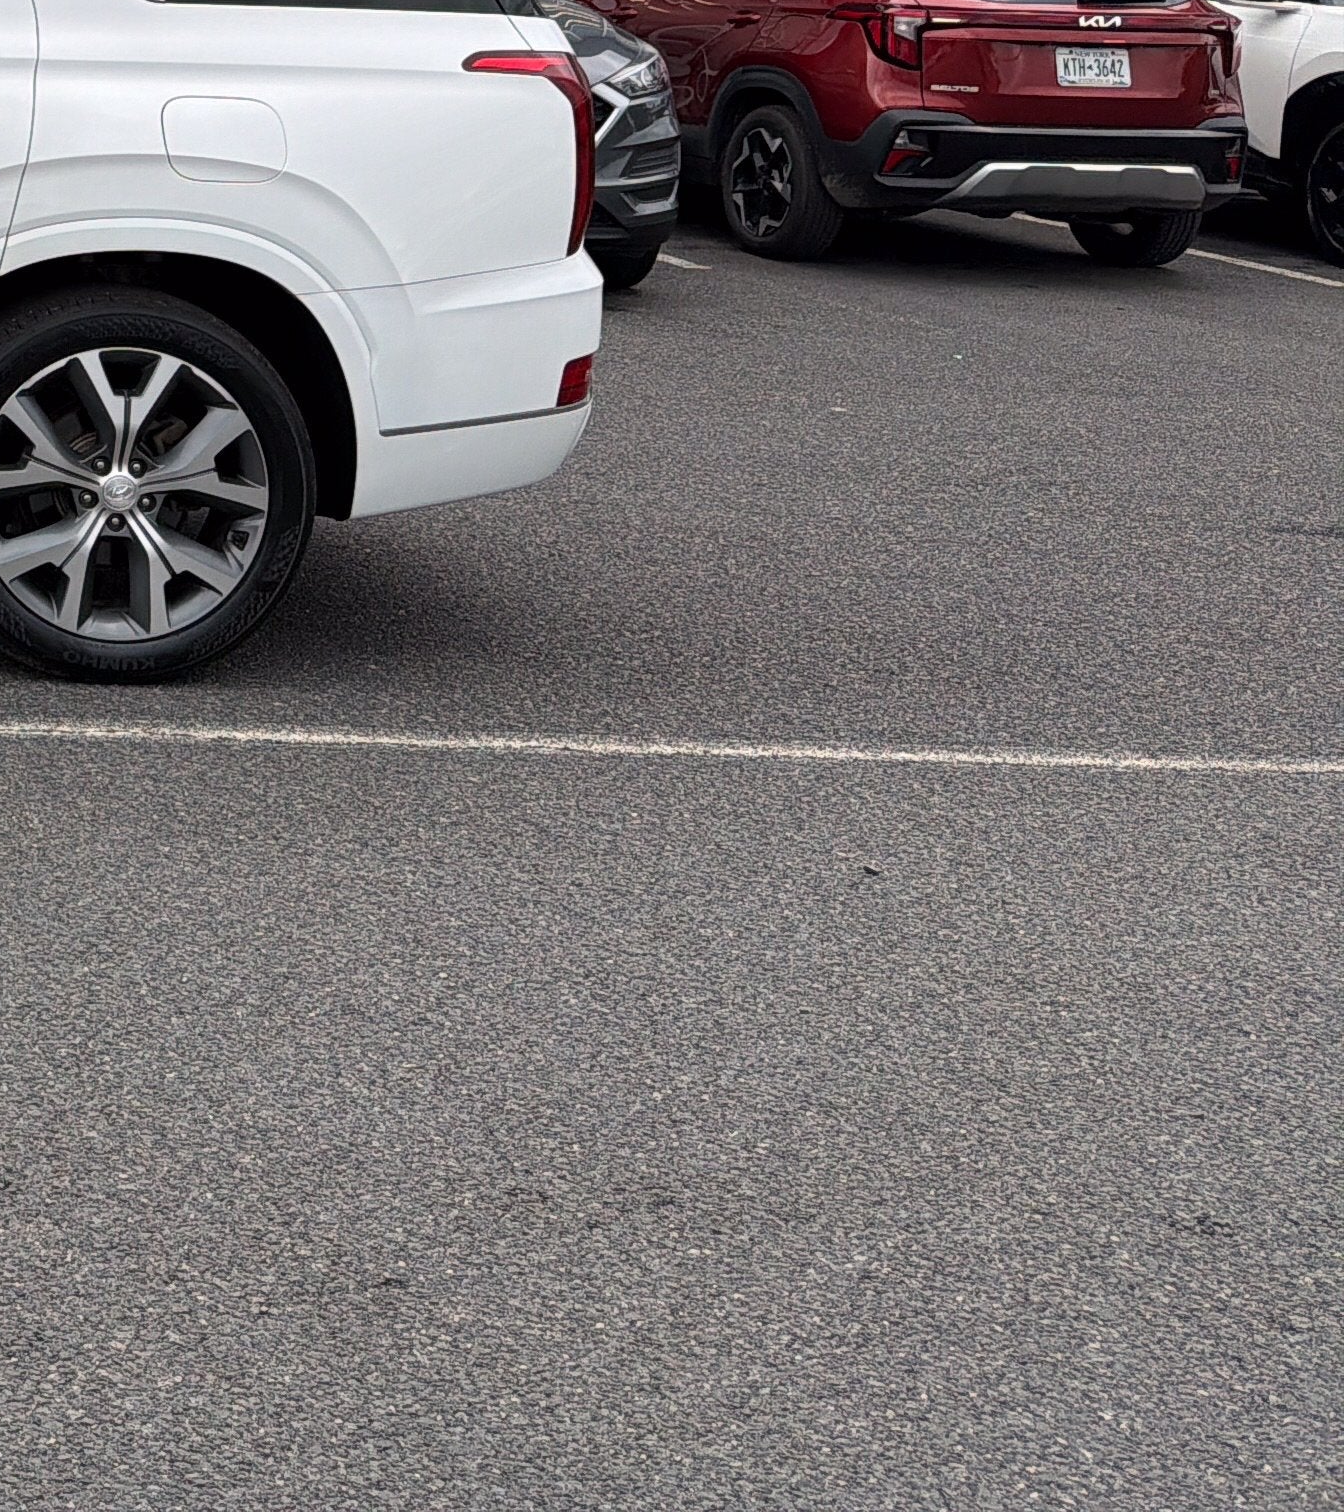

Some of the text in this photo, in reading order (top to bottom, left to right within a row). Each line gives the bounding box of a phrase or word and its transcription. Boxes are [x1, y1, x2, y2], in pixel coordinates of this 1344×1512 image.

[1078, 15, 1122, 28] KIA
[1063, 57, 1125, 78] KTH 3642
[63, 650, 156, 671] KUMHO
